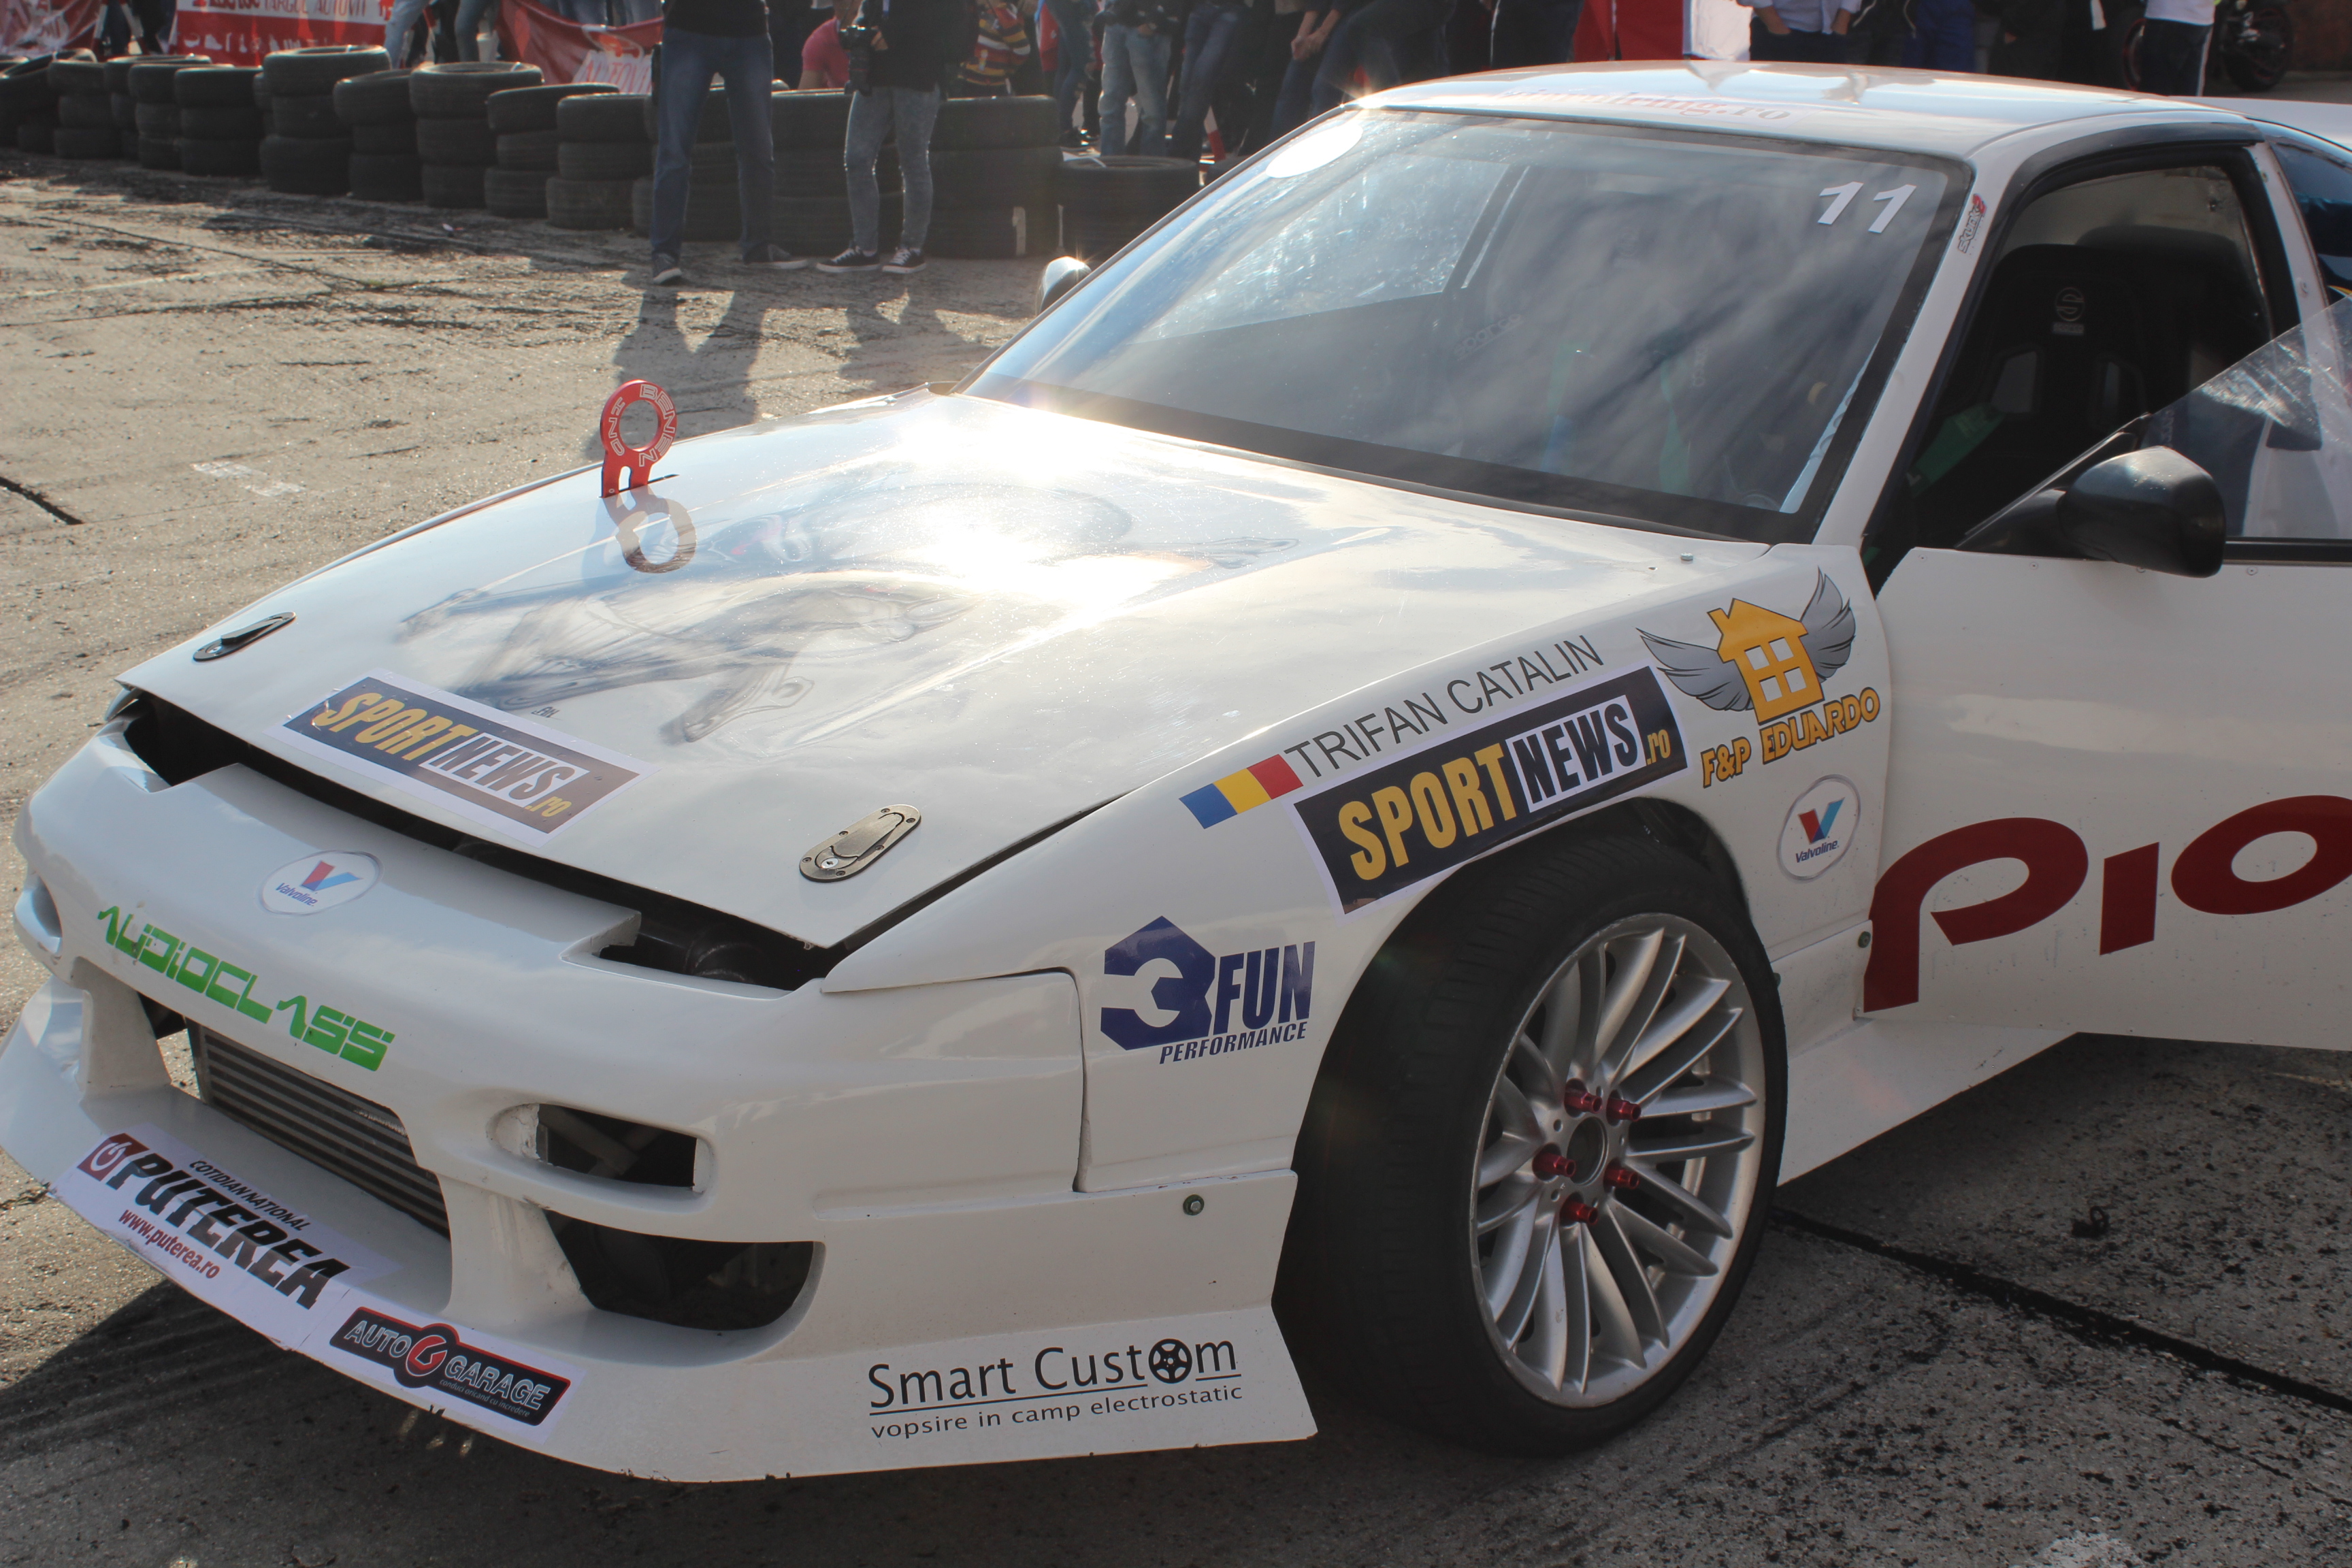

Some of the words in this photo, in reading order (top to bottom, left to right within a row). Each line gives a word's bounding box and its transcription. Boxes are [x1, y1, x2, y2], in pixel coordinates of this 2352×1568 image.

[1818, 181, 1916, 233] 11
[1284, 691, 1449, 778] TRIFAN
[1446, 634, 1605, 715] CATALIN
[1700, 736, 1752, 789] F&P
[1759, 687, 1880, 765] EDUARDO
[1795, 839, 1840, 864] Valvoline
[275, 882, 318, 907] Valvoline
[1213, 941, 1316, 1036] FUN
[1159, 1021, 1308, 1065] PERFORMANCE
[189, 1160, 248, 1196] COTIDIAN
[105, 1153, 352, 1310] PUTEREA
[118, 1209, 221, 1279] www.puterea.ro
[343, 1320, 412, 1358] AUTO
[444, 1355, 551, 1410] GARAGE
[868, 1357, 1016, 1409] Smart
[439, 1379, 466, 1393] conduci
[489, 1397, 499, 1406] cu
[497, 1401, 531, 1418] incredere
[870, 1416, 968, 1439] vopsire
[978, 1411, 1001, 1428] in
[1011, 1403, 1081, 1424] camp
[1090, 1384, 1243, 1416] electrostatic
